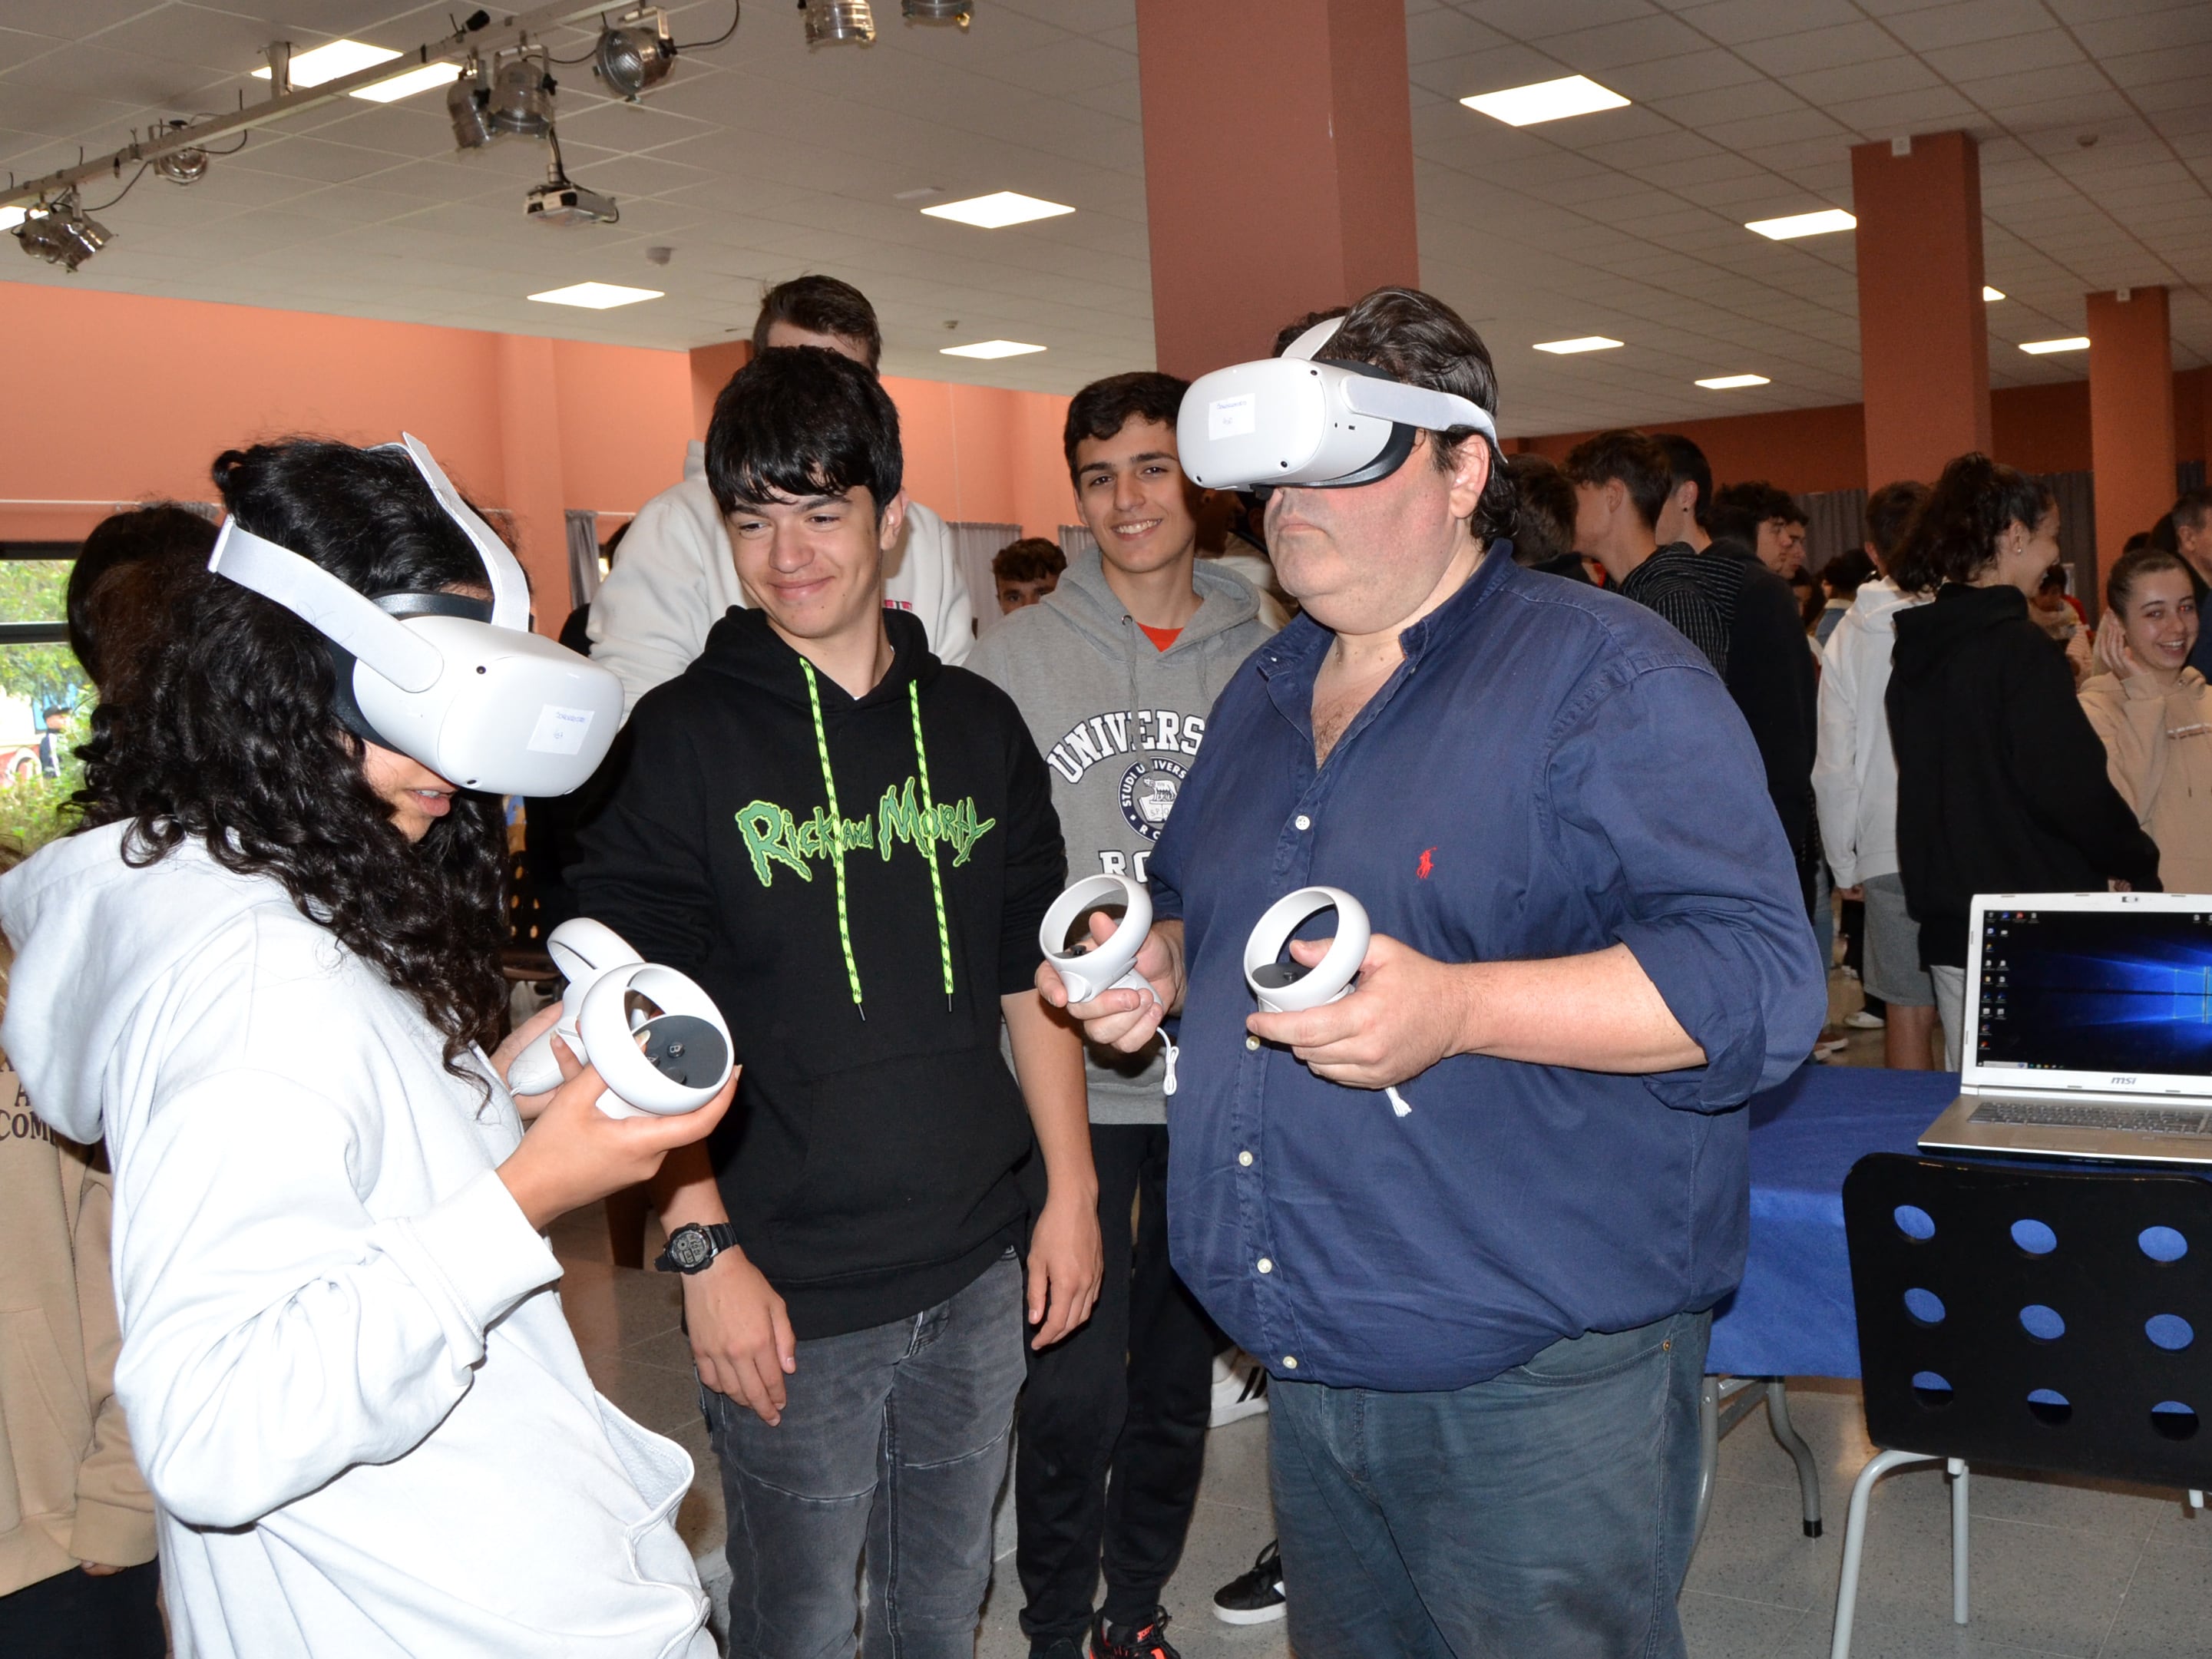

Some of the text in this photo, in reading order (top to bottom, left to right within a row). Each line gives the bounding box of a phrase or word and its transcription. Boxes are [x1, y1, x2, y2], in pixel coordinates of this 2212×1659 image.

[1122, 759, 1187, 808] STUDI UIVERS
[670, 1045, 682, 1053] B
[2111, 1076, 2138, 1086] msi
